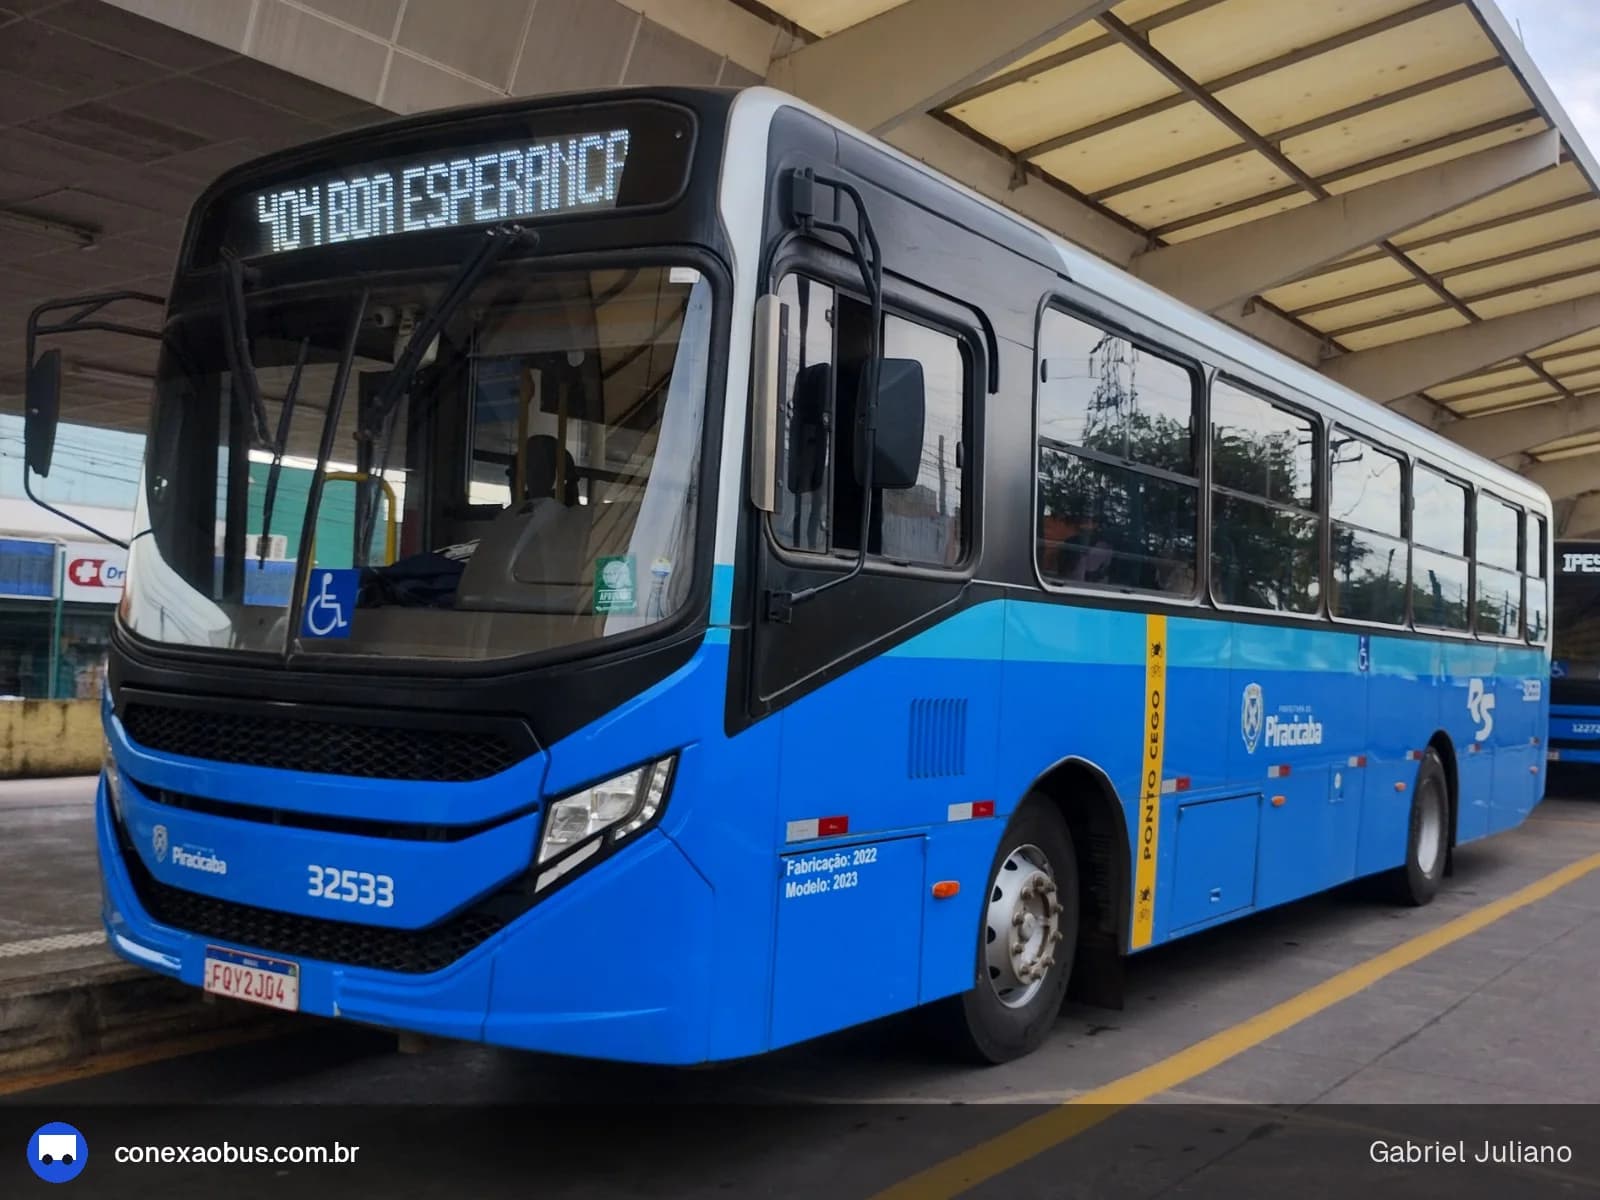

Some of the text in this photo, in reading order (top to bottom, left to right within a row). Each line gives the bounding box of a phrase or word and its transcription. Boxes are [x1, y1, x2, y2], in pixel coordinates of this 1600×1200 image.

[257, 185, 321, 253] 404
[328, 173, 394, 244] BOA
[1265, 714, 1322, 747] Piracicaba
[1143, 690, 1161, 860] PONTO CEGO
[172, 846, 227, 874] Piracicaba
[786, 848, 877, 876] Fabricação: 2022
[308, 864, 394, 908] 32533
[785, 871, 858, 898] Modelo: 2023
[212, 963, 285, 1002] FQY2J04
